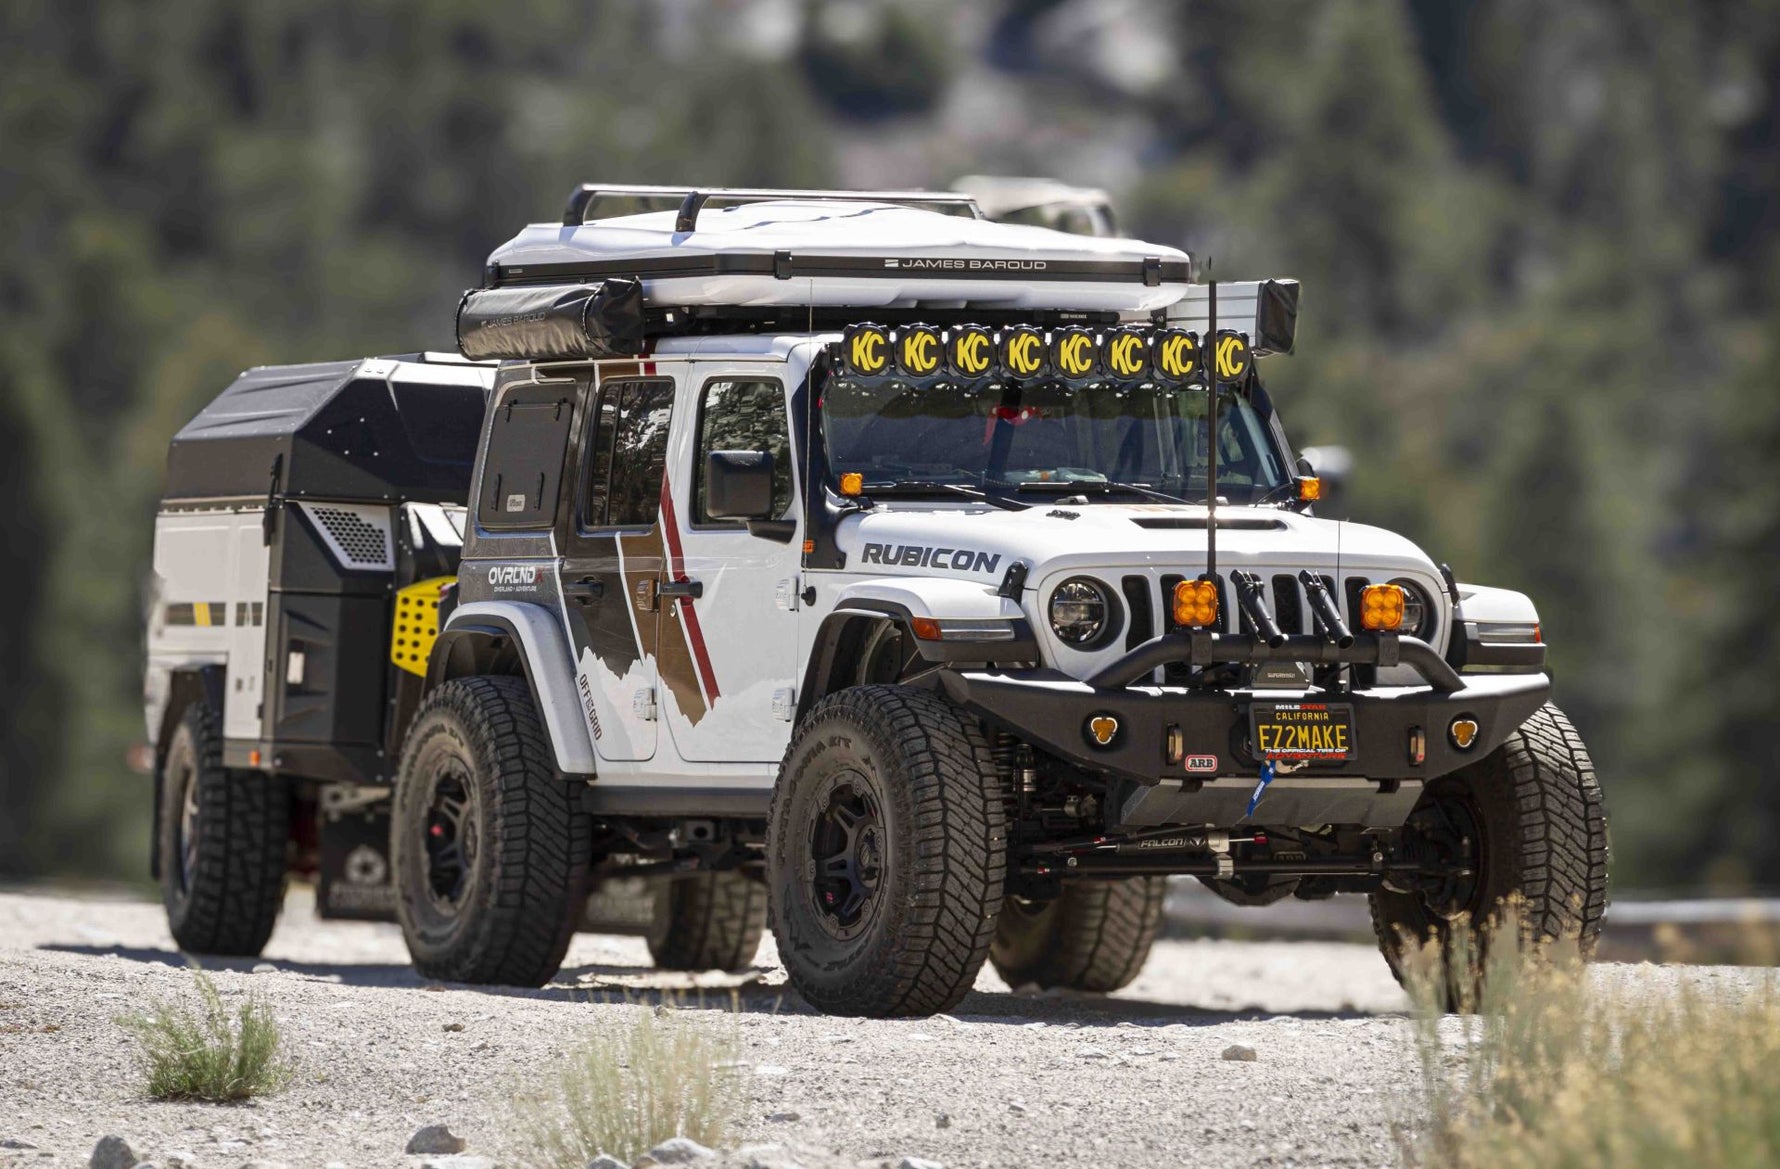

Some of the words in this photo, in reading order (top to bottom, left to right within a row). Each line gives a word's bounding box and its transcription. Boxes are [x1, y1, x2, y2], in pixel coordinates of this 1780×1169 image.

[902, 259, 965, 269] JAMES
[969, 260, 1047, 270] BAROUD
[852, 331, 885, 371] KC
[904, 331, 937, 372] KC
[957, 332, 989, 373] KC
[1009, 333, 1040, 373] KC
[1060, 334, 1092, 374] KC
[1111, 334, 1143, 375] KC
[1162, 335, 1193, 376] KC
[1216, 336, 1244, 377] KC
[861, 543, 1002, 574] RUBICON
[579, 673, 592, 698] OFF
[589, 708, 603, 741] GRID
[1275, 712, 1329, 721] CALIFORNIA
[1258, 725, 1349, 751] EZ2MAKE
[1189, 758, 1214, 768] ARB
[1140, 838, 1184, 848] FALCON
